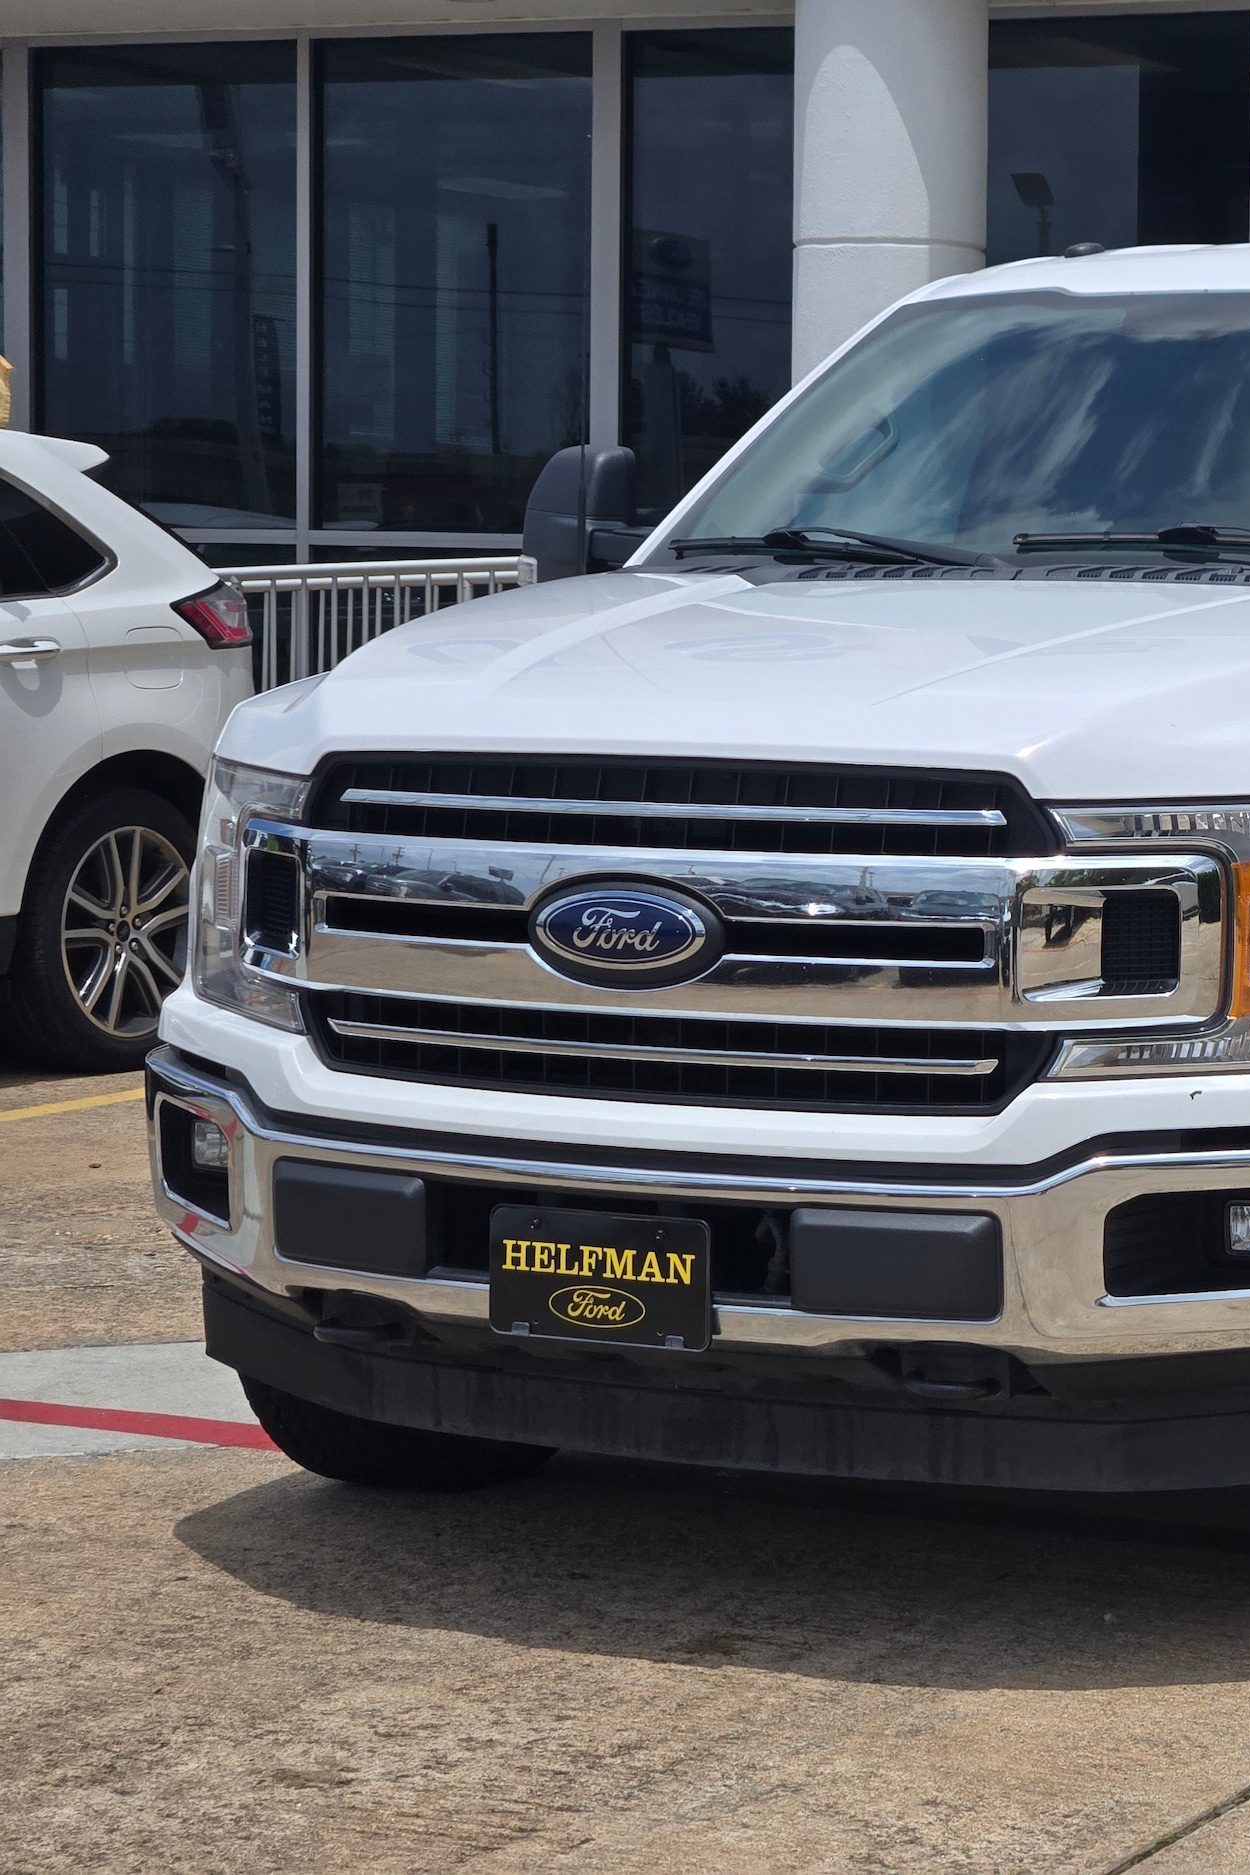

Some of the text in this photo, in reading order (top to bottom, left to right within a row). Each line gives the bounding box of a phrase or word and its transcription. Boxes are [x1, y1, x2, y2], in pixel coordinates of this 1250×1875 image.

[572, 906, 663, 951] Ford
[501, 1238, 696, 1285] HELFMAN
[567, 1289, 626, 1321] Ford
